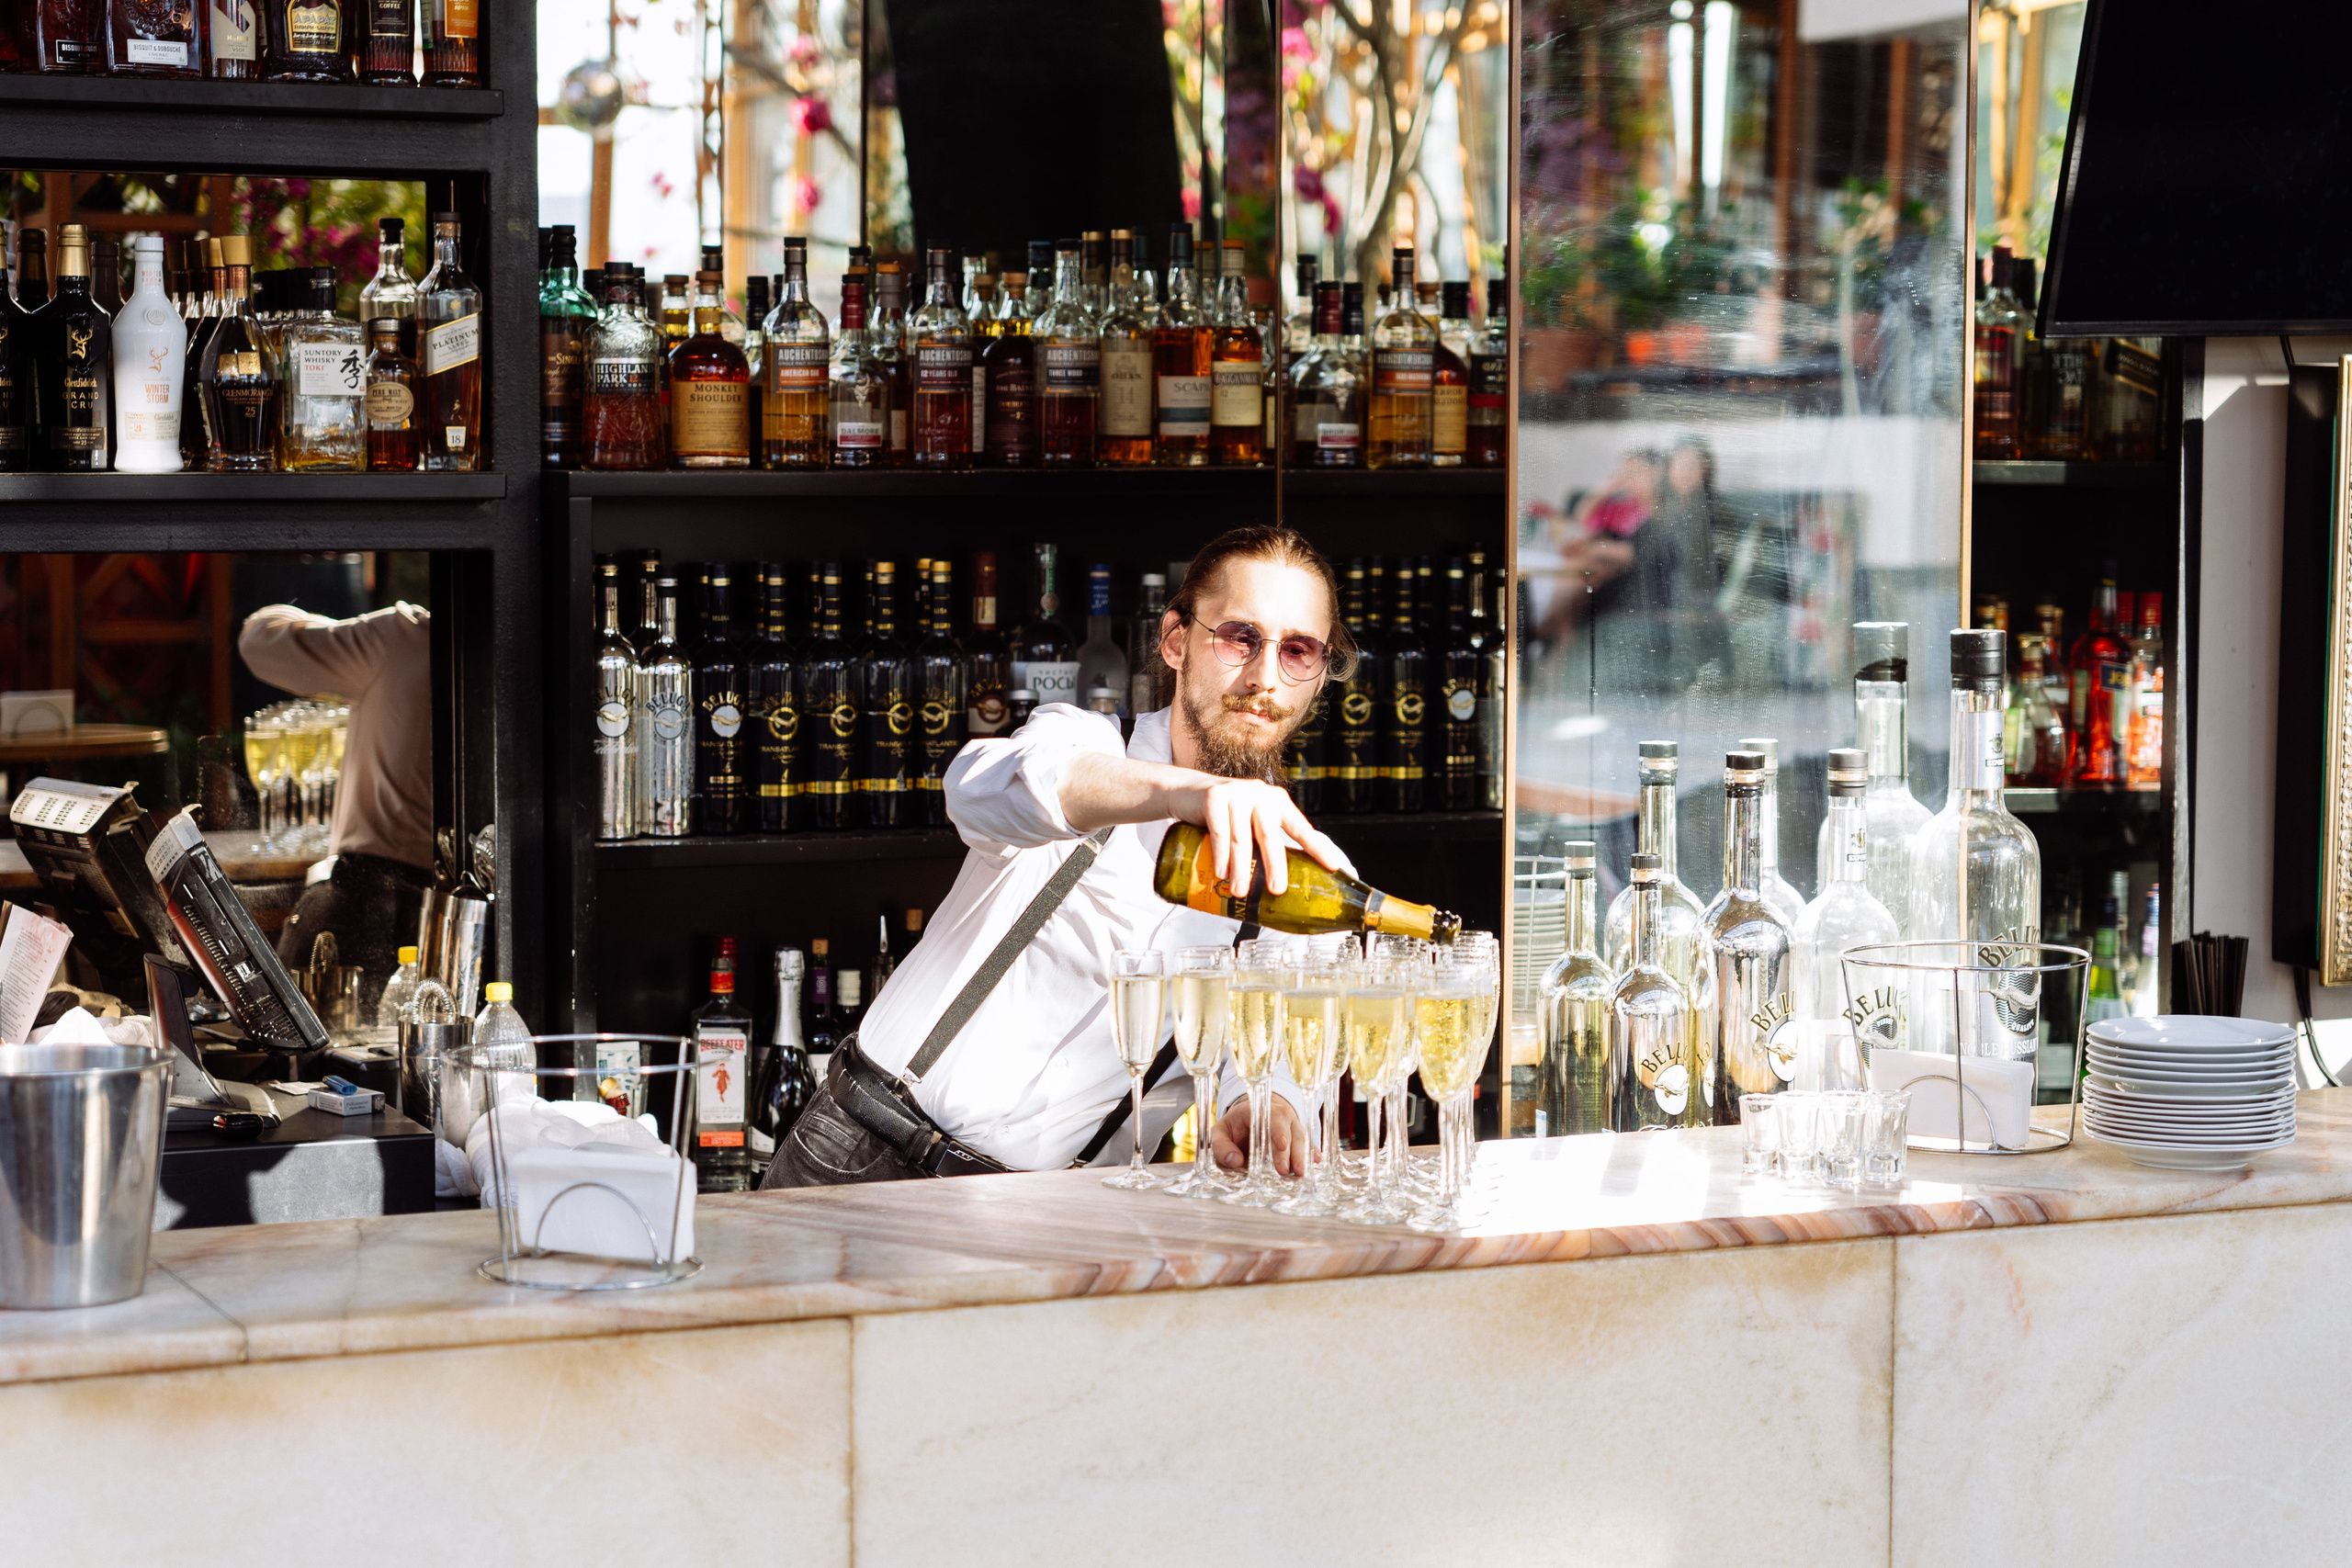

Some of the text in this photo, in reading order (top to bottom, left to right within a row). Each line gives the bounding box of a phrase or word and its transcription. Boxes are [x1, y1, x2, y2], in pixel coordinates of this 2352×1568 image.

[432, 328, 480, 350] PLATINUM
[597, 365, 654, 374] HIGHLAND
[64, 378, 98, 387] Glenfiddich
[597, 374, 639, 384] PARK 12
[144, 384, 170, 393] WINTER
[695, 384, 739, 393] MONKEY
[62, 391, 99, 400] GRAND
[147, 394, 169, 403] STORM
[71, 400, 94, 409] CRU
[244, 406, 256, 416] 25
[451, 434, 461, 445] 18
[646, 690, 692, 713] BELUGA
[702, 691, 747, 713] BELUGA
[700, 1038, 745, 1052] BEEFEATER
